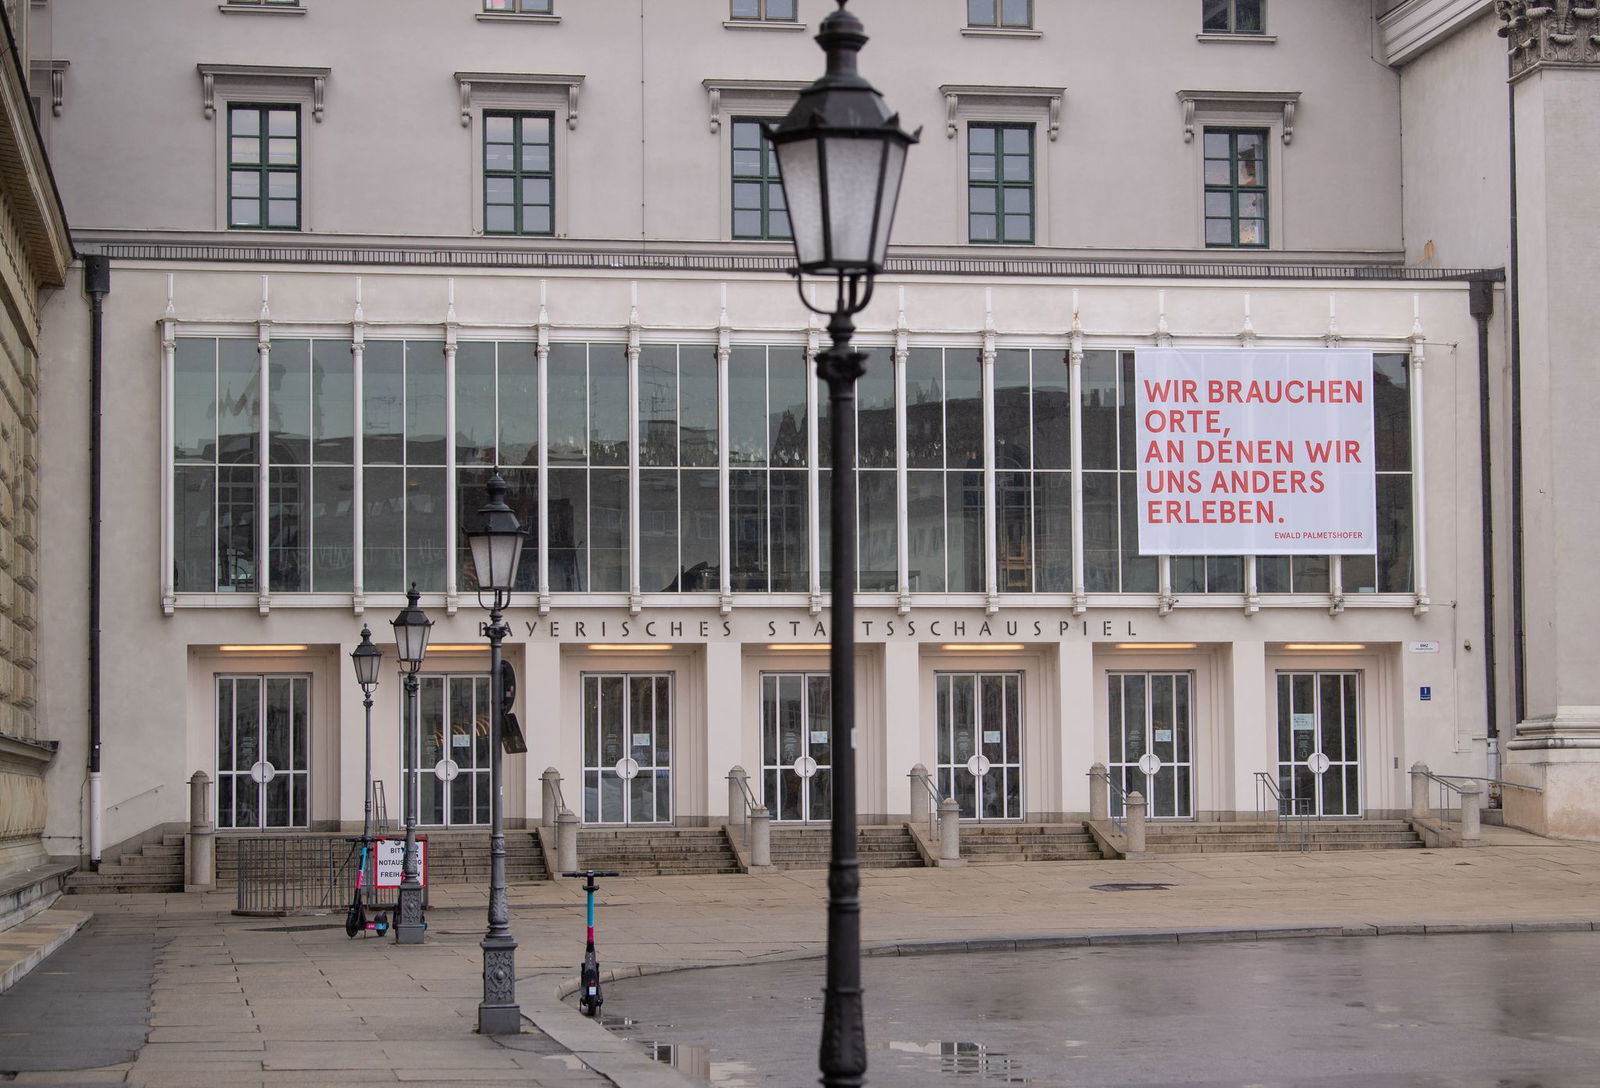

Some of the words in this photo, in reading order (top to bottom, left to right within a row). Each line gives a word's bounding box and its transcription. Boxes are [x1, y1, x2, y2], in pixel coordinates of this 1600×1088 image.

[1143, 379, 1199, 403] WIR
[1207, 379, 1364, 403] BRAUCHEN
[1144, 409, 1231, 438] ORTE,
[1144, 439, 1184, 463] AN
[1196, 440, 1294, 463] DENEN
[1305, 440, 1362, 463] WIR
[1146, 469, 1202, 493] UNS
[1210, 469, 1325, 494] ANDERS
[1147, 500, 1285, 524] ERLEBEN.
[1274, 531, 1301, 539] EWALD
[1302, 531, 1363, 539] PALMETSHOFER
[478, 621, 732, 637] BAYERISCHES
[768, 620, 1137, 637] STATSSCHAUSPIEL
